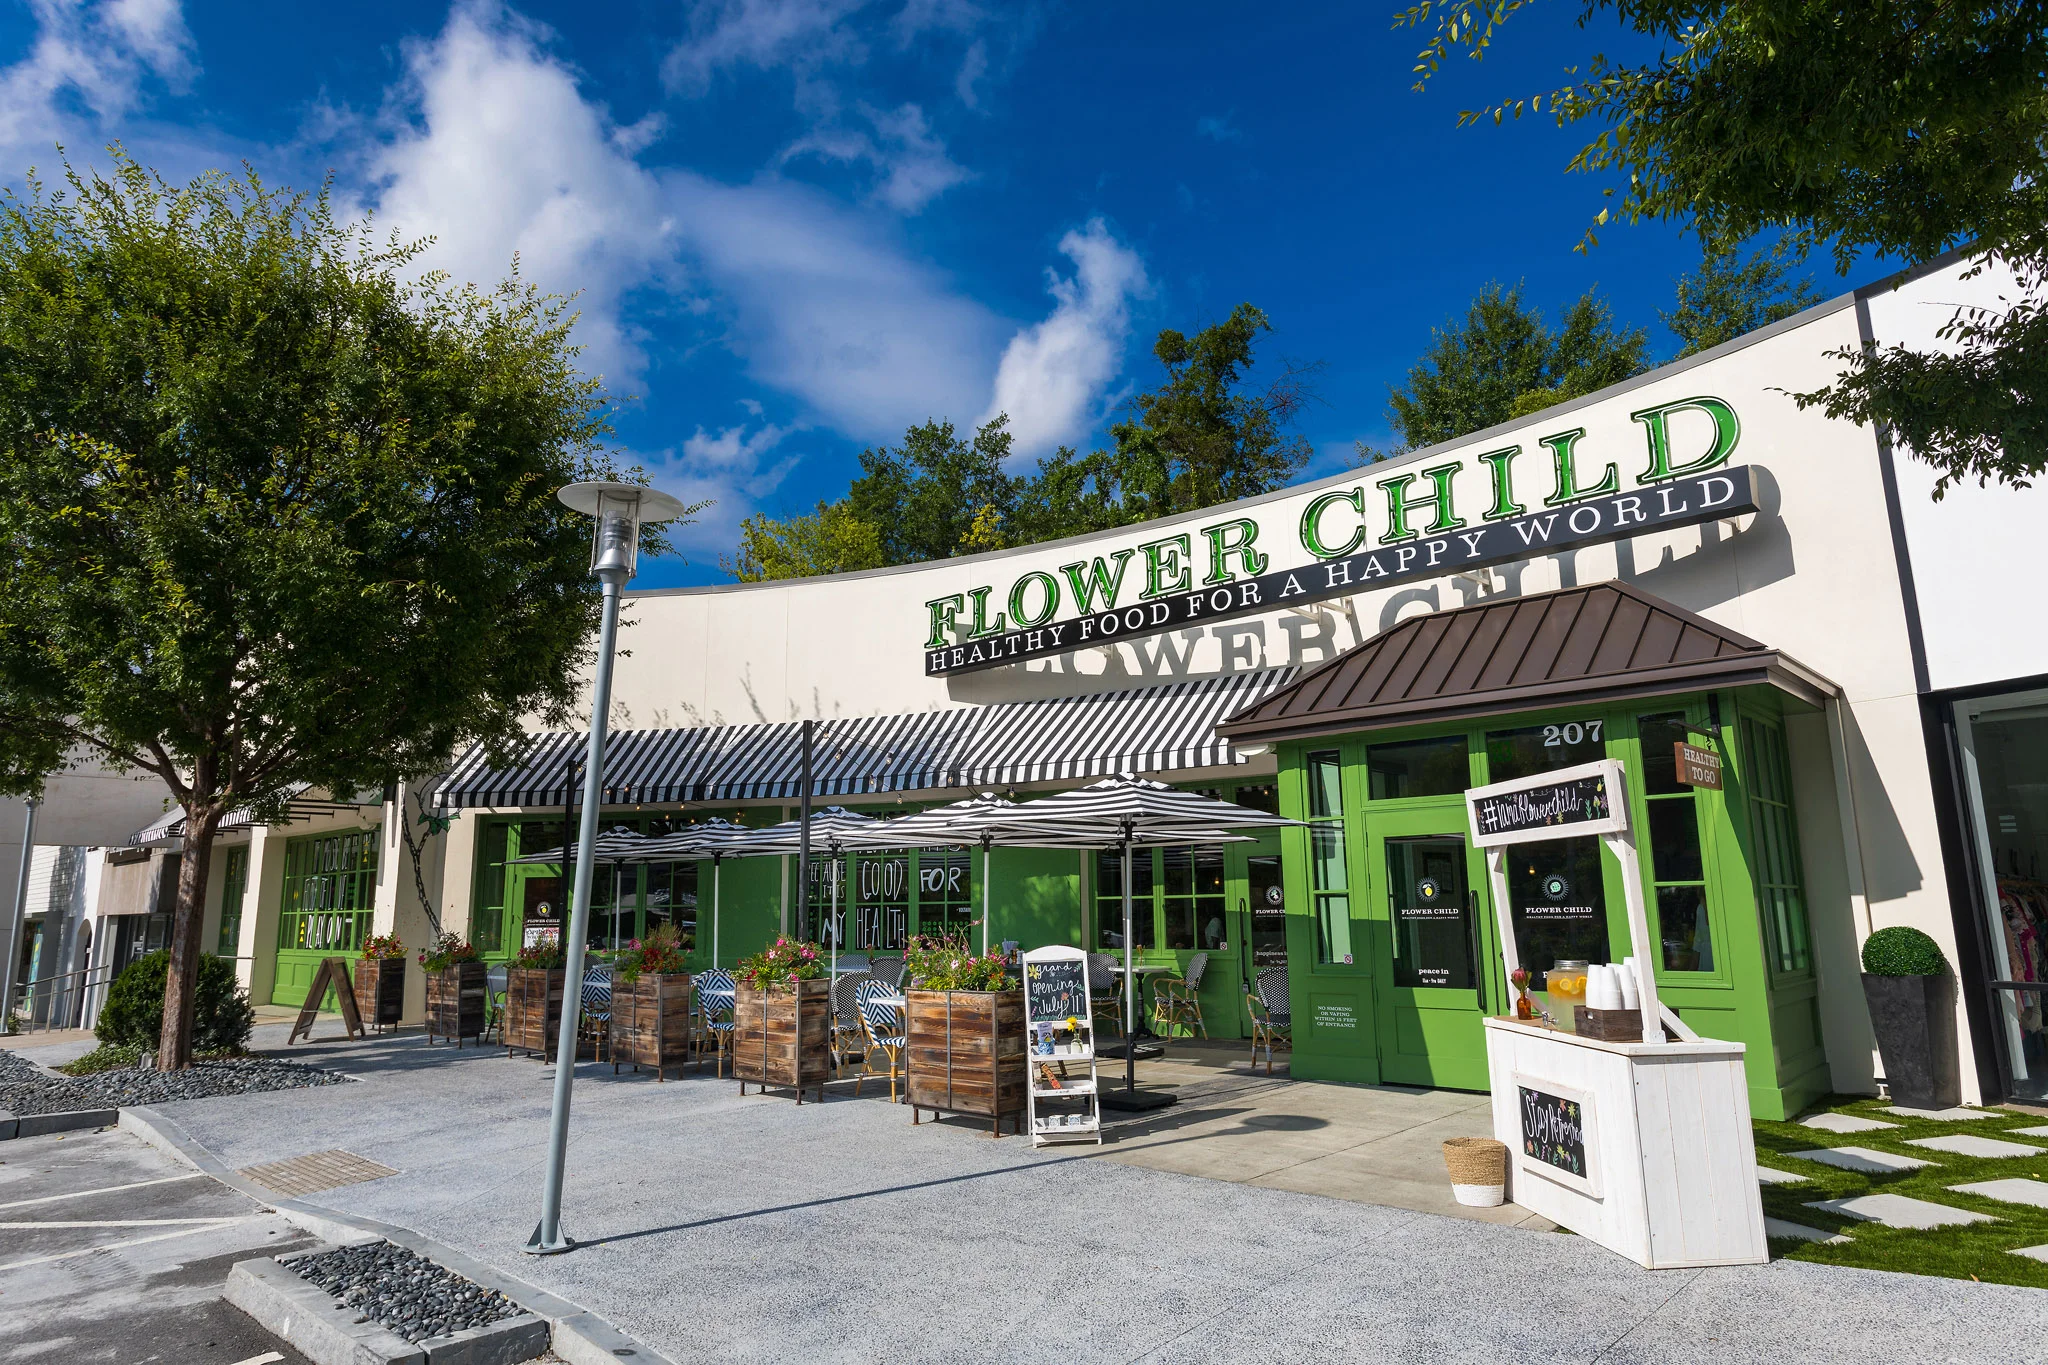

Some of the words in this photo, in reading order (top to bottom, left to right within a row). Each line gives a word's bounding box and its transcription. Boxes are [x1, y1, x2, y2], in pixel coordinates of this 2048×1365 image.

[924, 517, 1269, 649] FLOWER
[1299, 395, 1741, 560] CHILD
[931, 624, 1066, 671] HEALTHY
[1080, 603, 1170, 640] FOOD
[1187, 582, 1262, 617] FOR
[1279, 573, 1306, 598] A
[1324, 530, 1487, 588] HAPPY
[1510, 476, 1735, 546] WORLD
[1543, 720, 1603, 747] 207
[1683, 748, 1720, 769] HEALTHY
[1692, 766, 1704, 781] TO
[1704, 769, 1716, 784] GO
[1483, 787, 1584, 832] #iamaflowerchild
[808, 861, 846, 882] ECAUSE
[862, 859, 903, 900] GOOD
[920, 867, 961, 893] FOR
[822, 911, 846, 945] MY
[856, 906, 906, 949] HEALTH
[1036, 962, 1072, 979] grand
[1440, 967, 1449, 975] in
[1032, 980, 1079, 996] opening
[1039, 996, 1069, 1019] July
[1526, 1095, 1548, 1143] Stay
